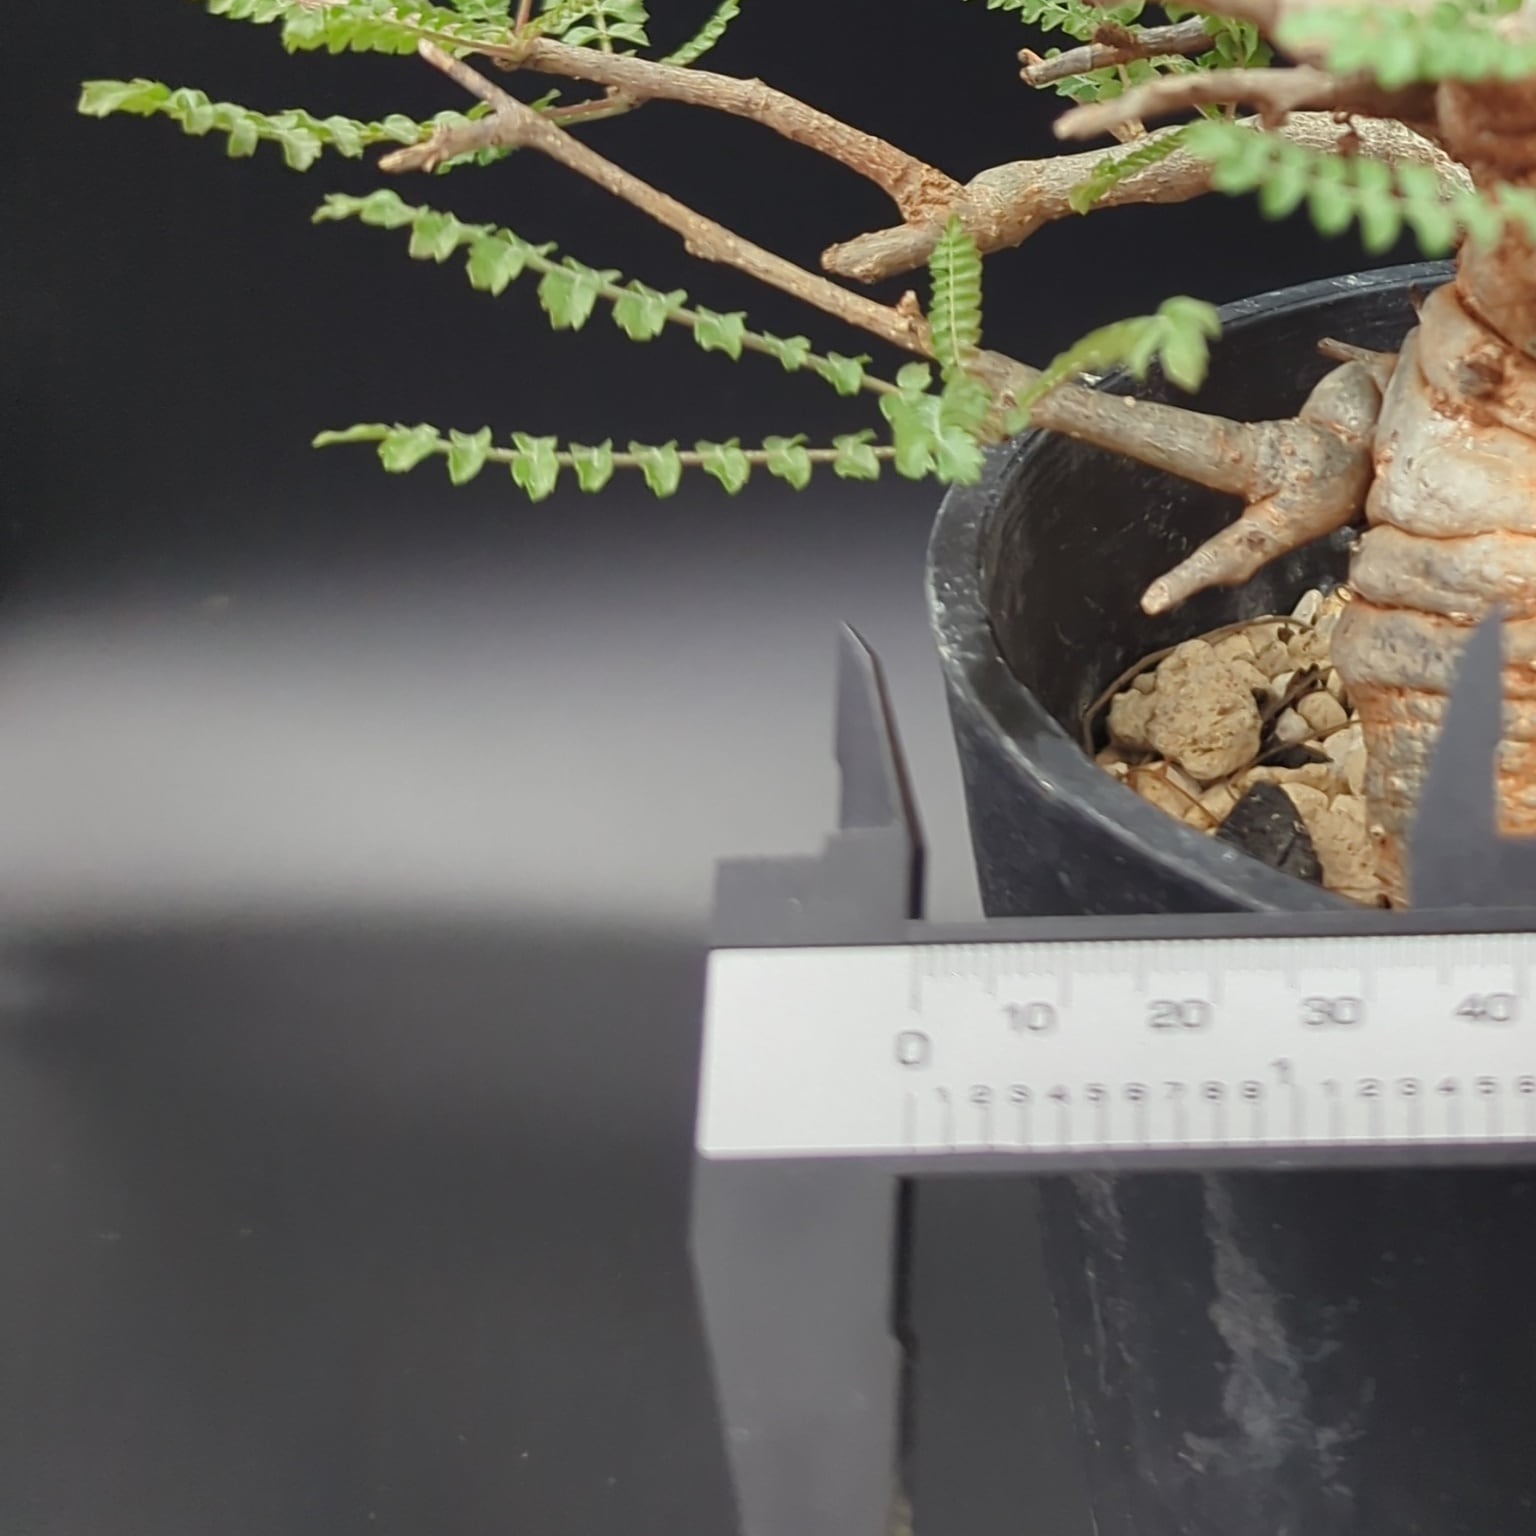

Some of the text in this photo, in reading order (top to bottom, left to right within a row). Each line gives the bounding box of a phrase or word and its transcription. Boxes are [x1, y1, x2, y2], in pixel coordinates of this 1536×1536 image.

[1146, 998, 1211, 1031] 20
[1301, 995, 1363, 1027] 30
[1454, 991, 1518, 1024] 40
